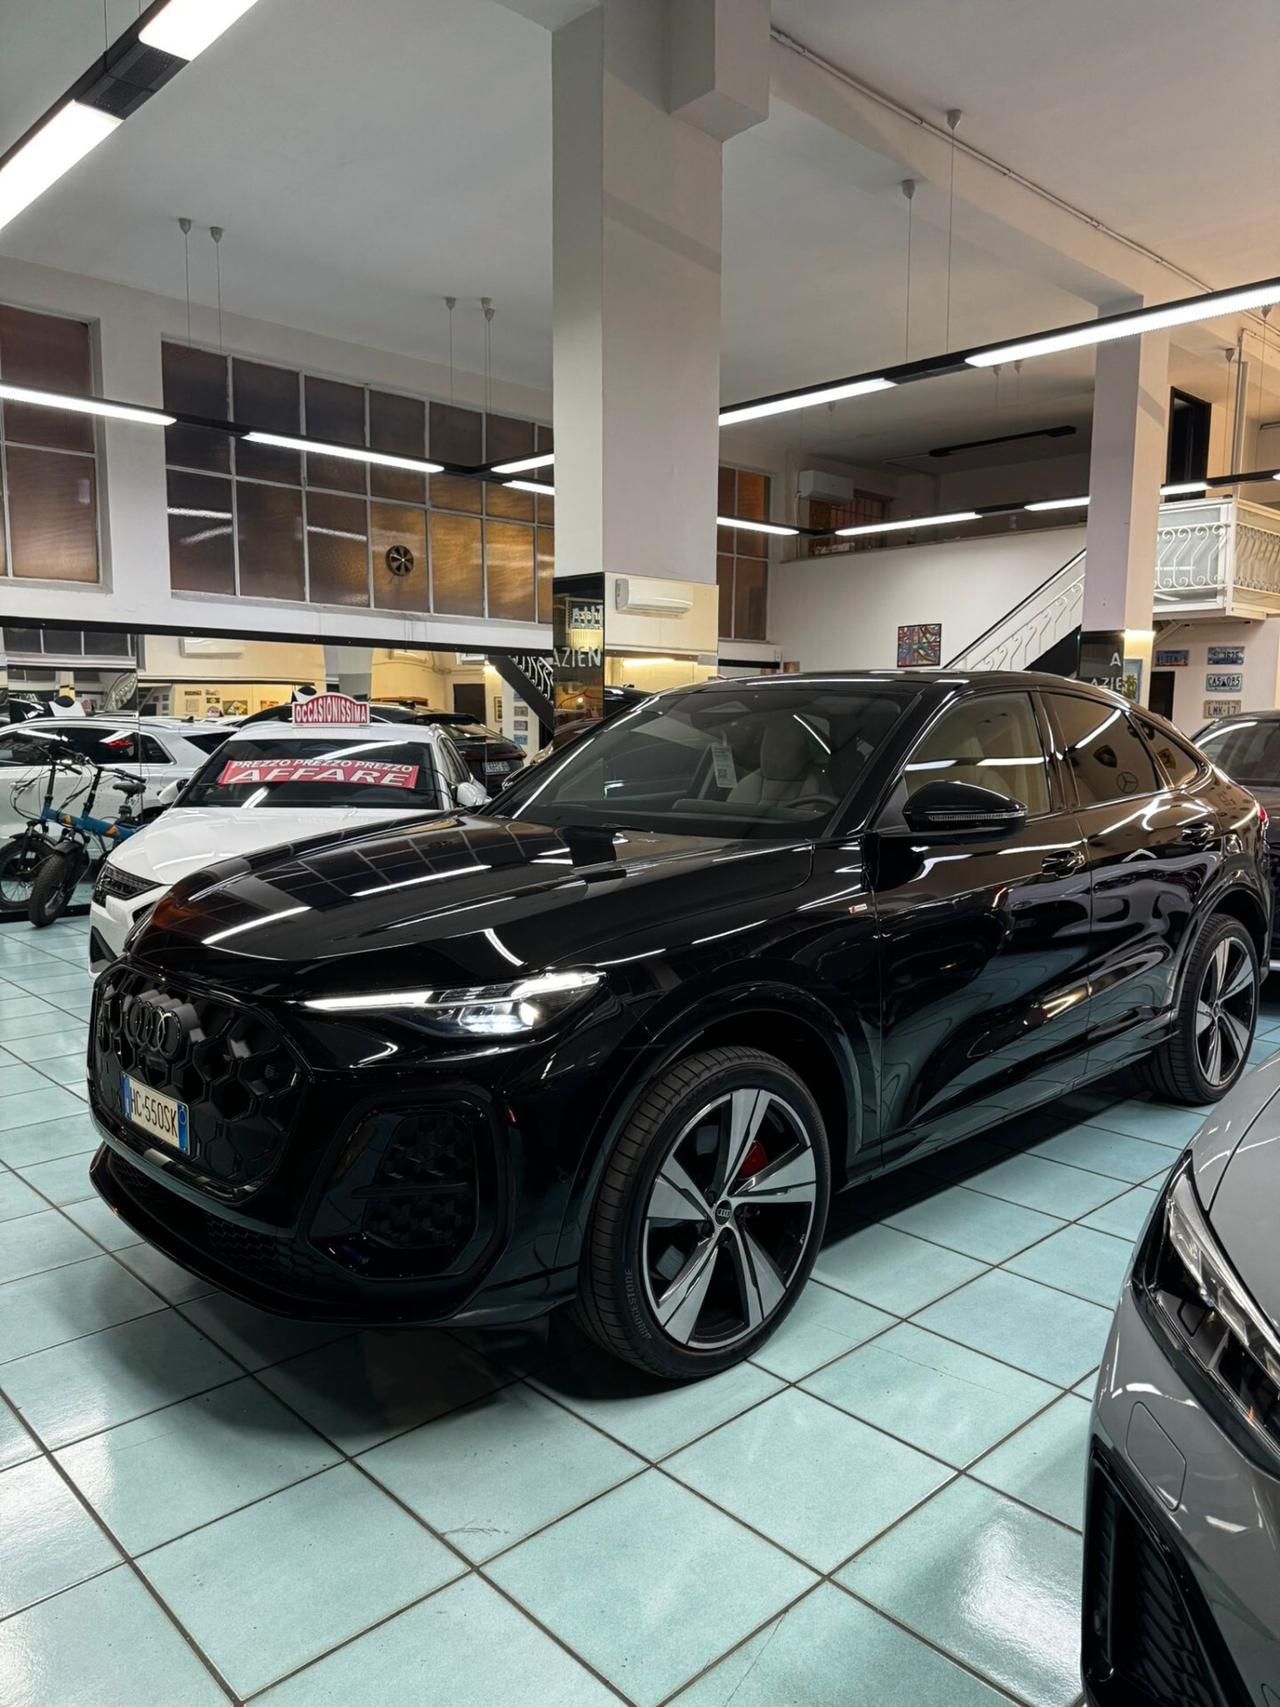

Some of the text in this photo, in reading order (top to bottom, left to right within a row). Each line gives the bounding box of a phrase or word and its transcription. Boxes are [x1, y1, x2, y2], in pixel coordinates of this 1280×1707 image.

[1109, 652, 1121, 666] A
[295, 696, 368, 722] OCCASIONISSIMA
[231, 758, 412, 773] PREZZO PREZZO PREZZO
[228, 766, 410, 786] AFFARE
